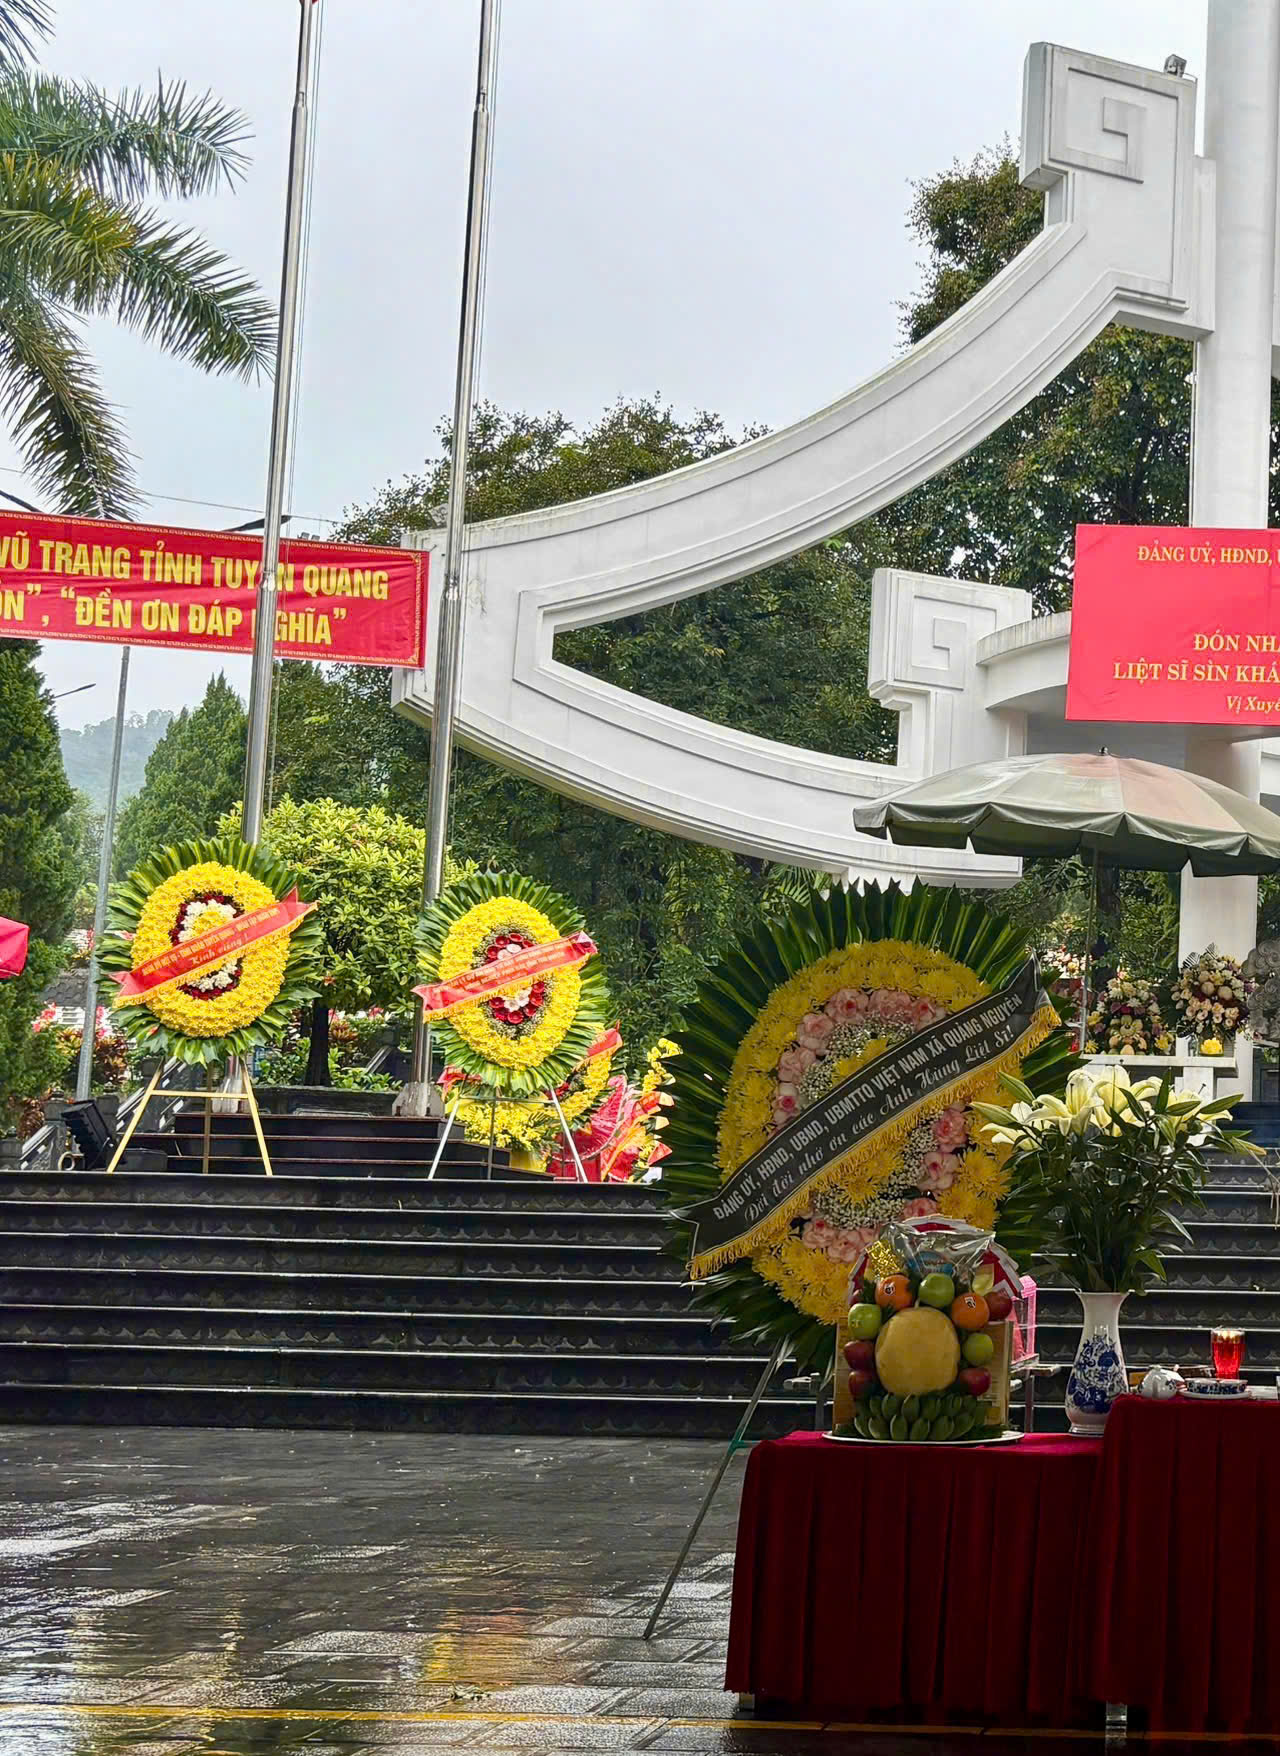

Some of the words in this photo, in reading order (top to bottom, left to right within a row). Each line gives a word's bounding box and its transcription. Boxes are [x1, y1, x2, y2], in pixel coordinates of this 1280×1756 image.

[39, 539, 131, 579] TRANG
[139, 540, 202, 585] TỈNH
[211, 555, 295, 592] TUYN
[303, 564, 389, 600] QUANG
[1137, 540, 1185, 562] ĐẢNG
[1219, 547, 1273, 567] HĐND,
[141, 599, 180, 633] ƠN
[188, 599, 243, 637] ĐÁP
[1193, 629, 1240, 652] ĐÓN
[1113, 657, 1163, 684] LIỆT
[1167, 659, 1188, 681] SĨ
[1193, 659, 1229, 682] SÌN
[1226, 695, 1242, 714] Vị
[713, 1189, 745, 1220] ĐẢNG
[756, 1147, 794, 1181] HĐND,
[789, 1119, 830, 1152] UBND,
[824, 1083, 876, 1125] UBMTTQ
[871, 1064, 901, 1091] VIỆT
[898, 1047, 930, 1074] NAM
[925, 1035, 947, 1058] XÃ
[943, 1018, 984, 1048] QUẢNG
[979, 993, 1023, 1029] NGUYÊN
[829, 1133, 849, 1151] ơn
[852, 1112, 876, 1135] các
[880, 1084, 914, 1115] Anh
